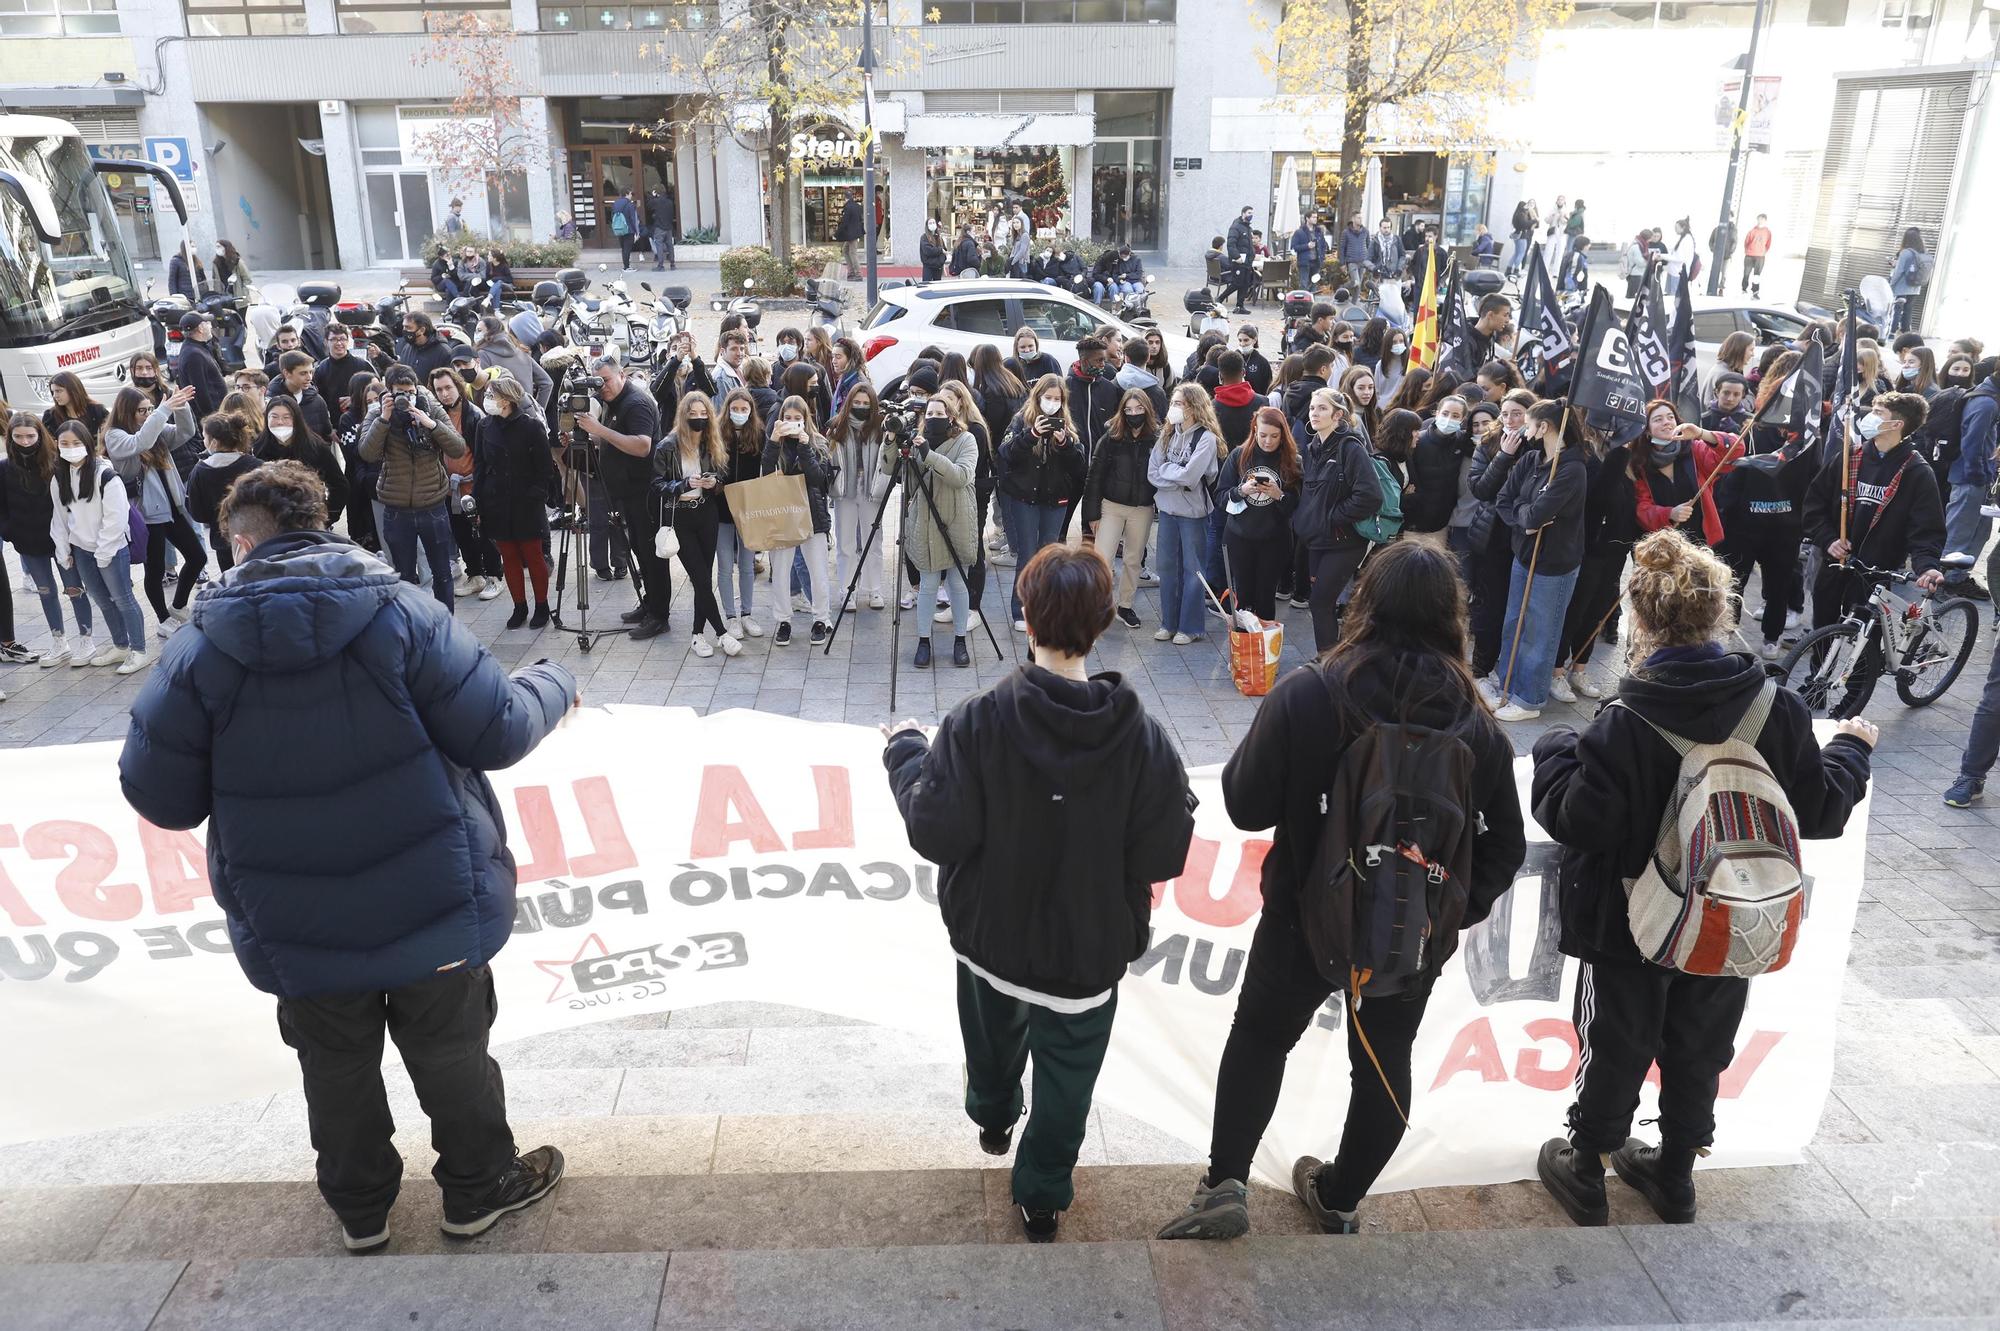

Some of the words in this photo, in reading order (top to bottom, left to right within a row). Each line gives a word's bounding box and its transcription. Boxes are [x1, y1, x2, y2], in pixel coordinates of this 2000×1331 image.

[403, 109, 441, 118] PROPERA
[98, 144, 139, 160] Ste
[154, 143, 180, 166] P
[790, 133, 861, 159] Stein
[56, 346, 101, 368] MONTAGUT
